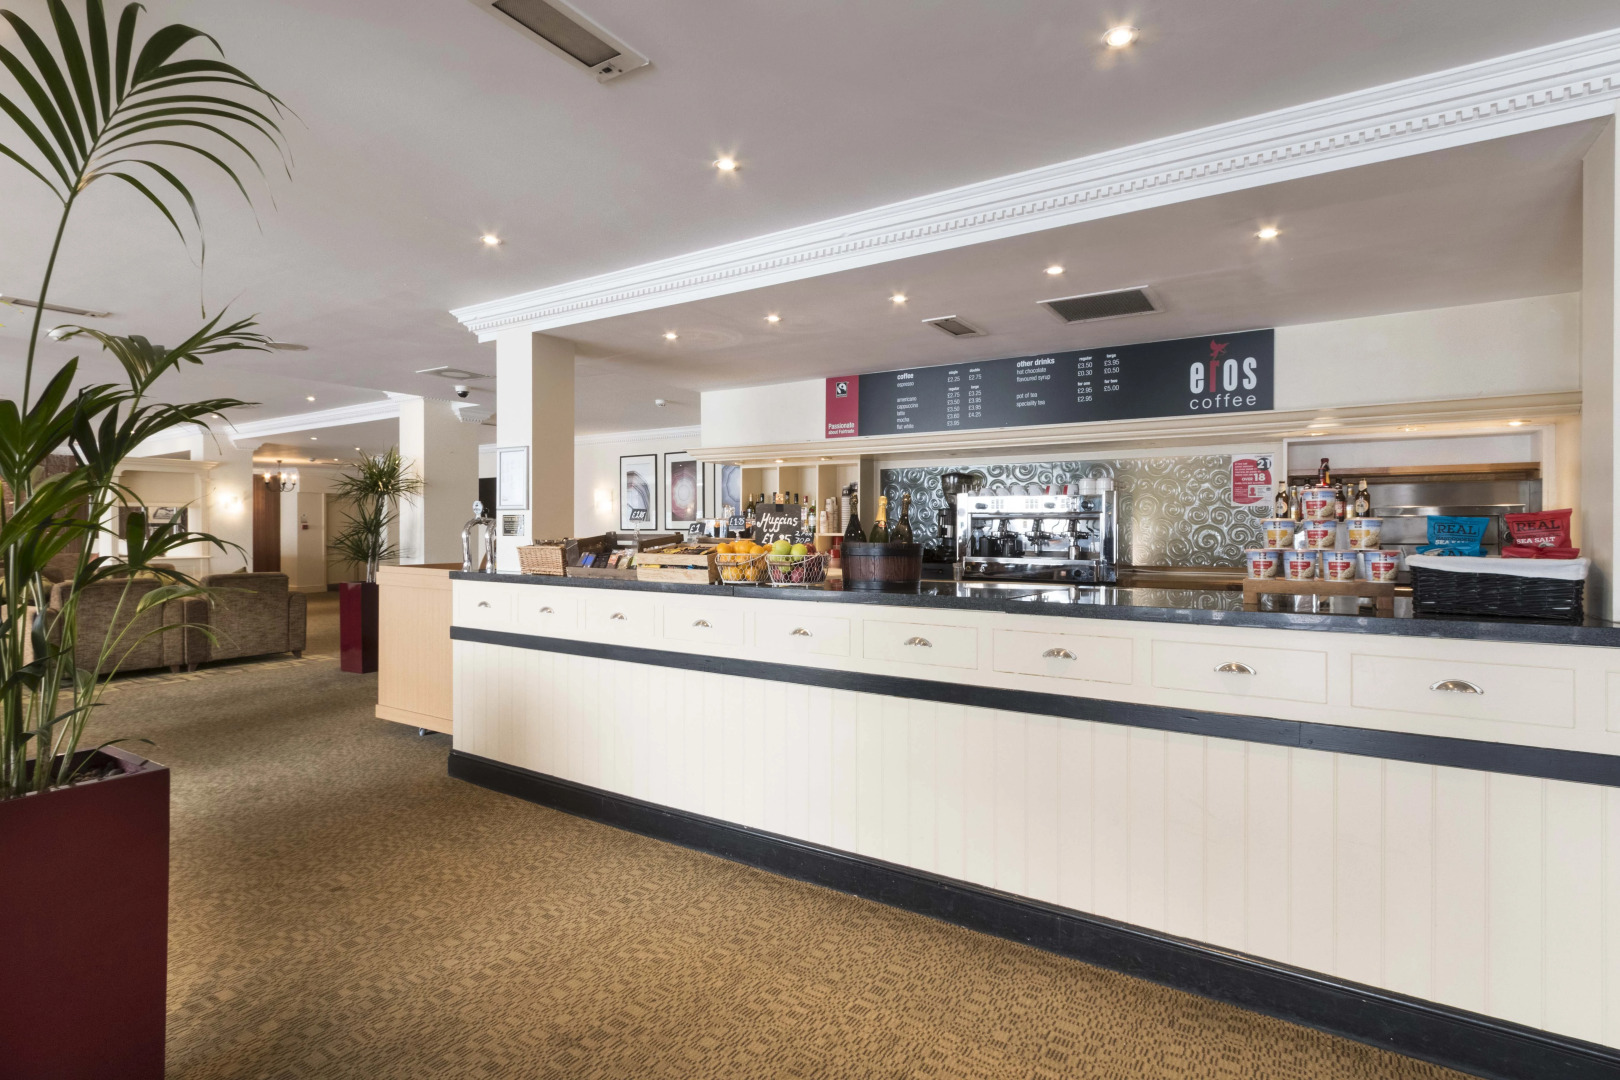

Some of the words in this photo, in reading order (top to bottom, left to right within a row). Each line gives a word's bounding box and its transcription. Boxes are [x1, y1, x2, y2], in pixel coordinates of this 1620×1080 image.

[1034, 358, 1055, 366] drinks
[1190, 356, 1257, 394] eros
[1190, 393, 1256, 410] coffee
[1257, 459, 1270, 469] 21
[1254, 473, 1266, 481] 18
[756, 512, 798, 532] Muffins
[1515, 520, 1560, 532] REAL
[1436, 524, 1476, 535] REAL
